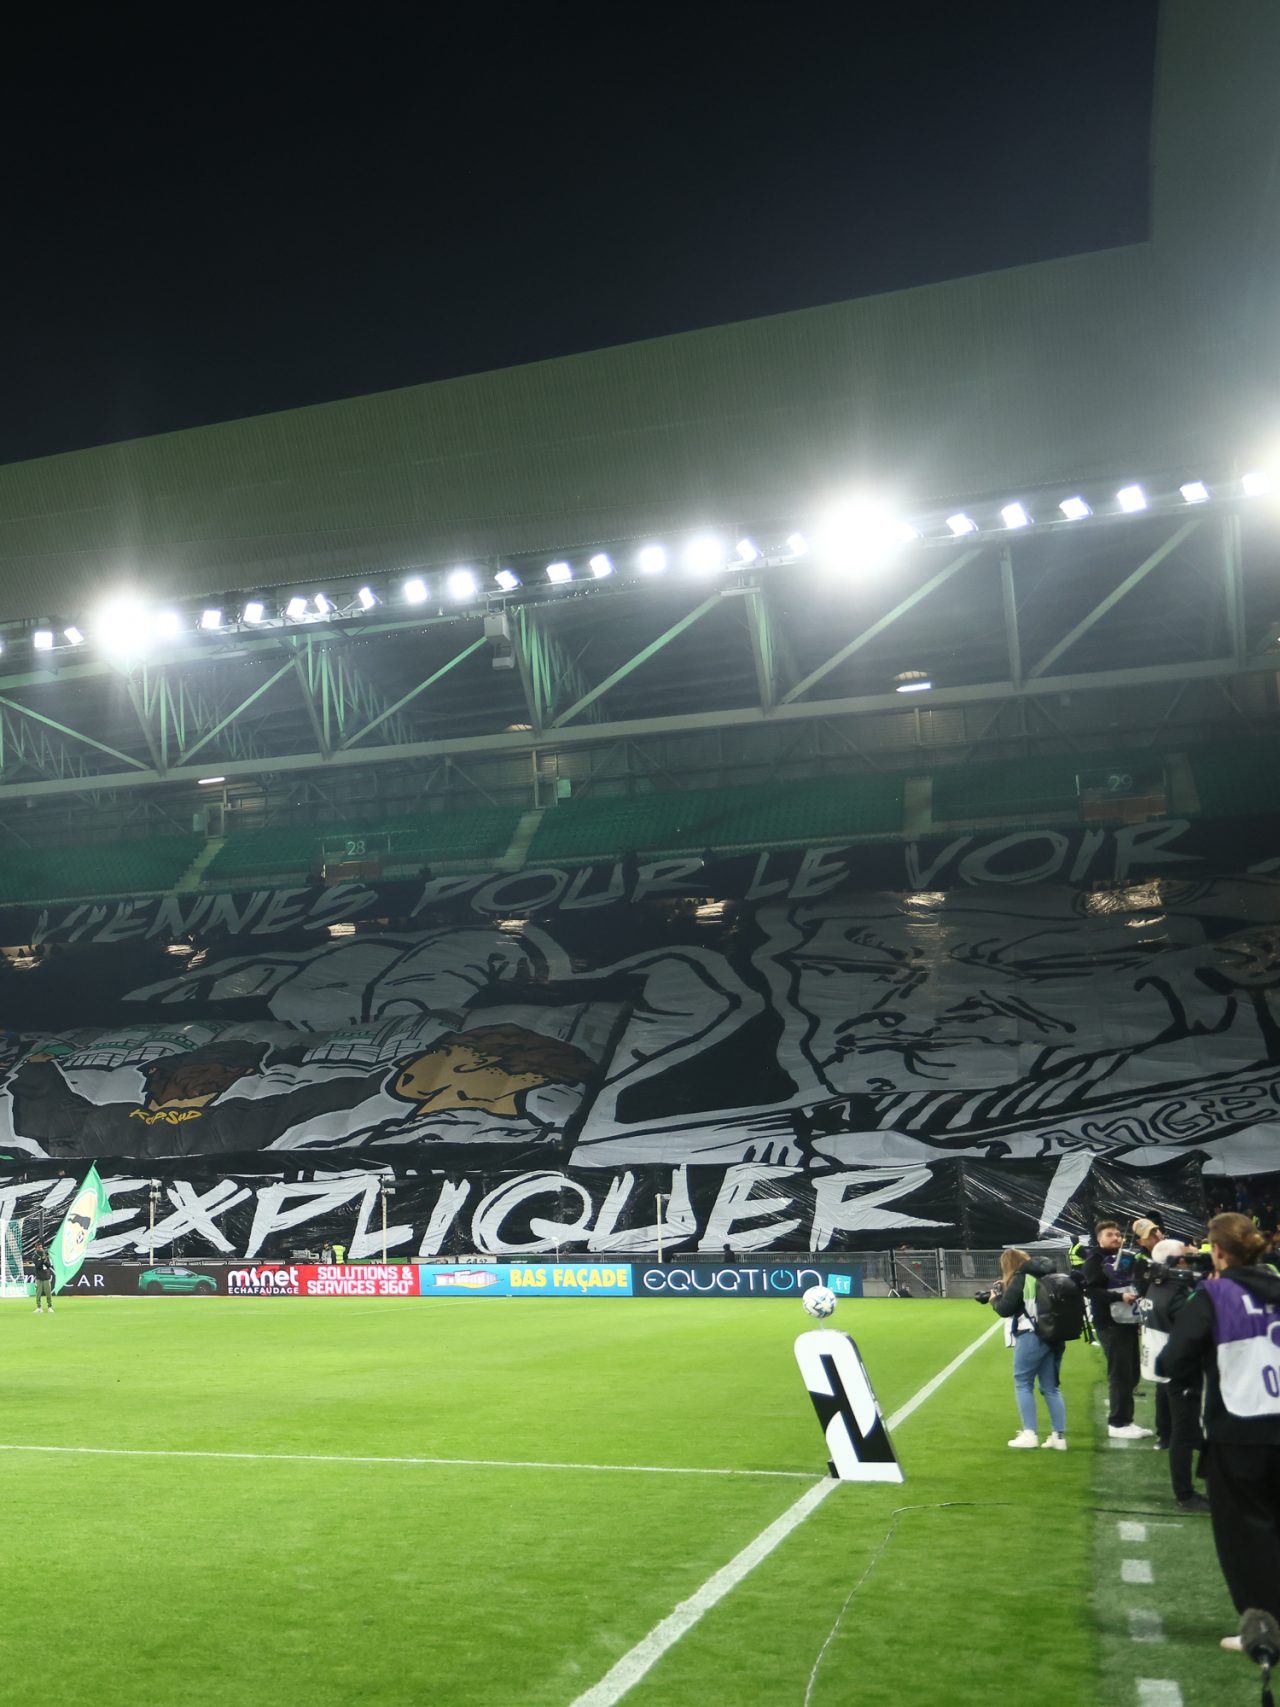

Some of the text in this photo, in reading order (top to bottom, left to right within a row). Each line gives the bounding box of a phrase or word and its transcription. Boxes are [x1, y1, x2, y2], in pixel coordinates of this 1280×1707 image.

[1107, 774, 1133, 791] 29
[347, 840, 366, 856] 28
[31, 883, 378, 944] VIENNES
[410, 857, 710, 917] POUR
[744, 846, 851, 901] LE
[905, 819, 1209, 891] VOIR
[1036, 1082, 1280, 1158] ANGE
[317, 1266, 413, 1280] SOLUTIONS &
[510, 1268, 628, 1293] BAS FAÇADE
[307, 1280, 413, 1294] SERVICES 360°
[794, 1328, 904, 1484] 2
